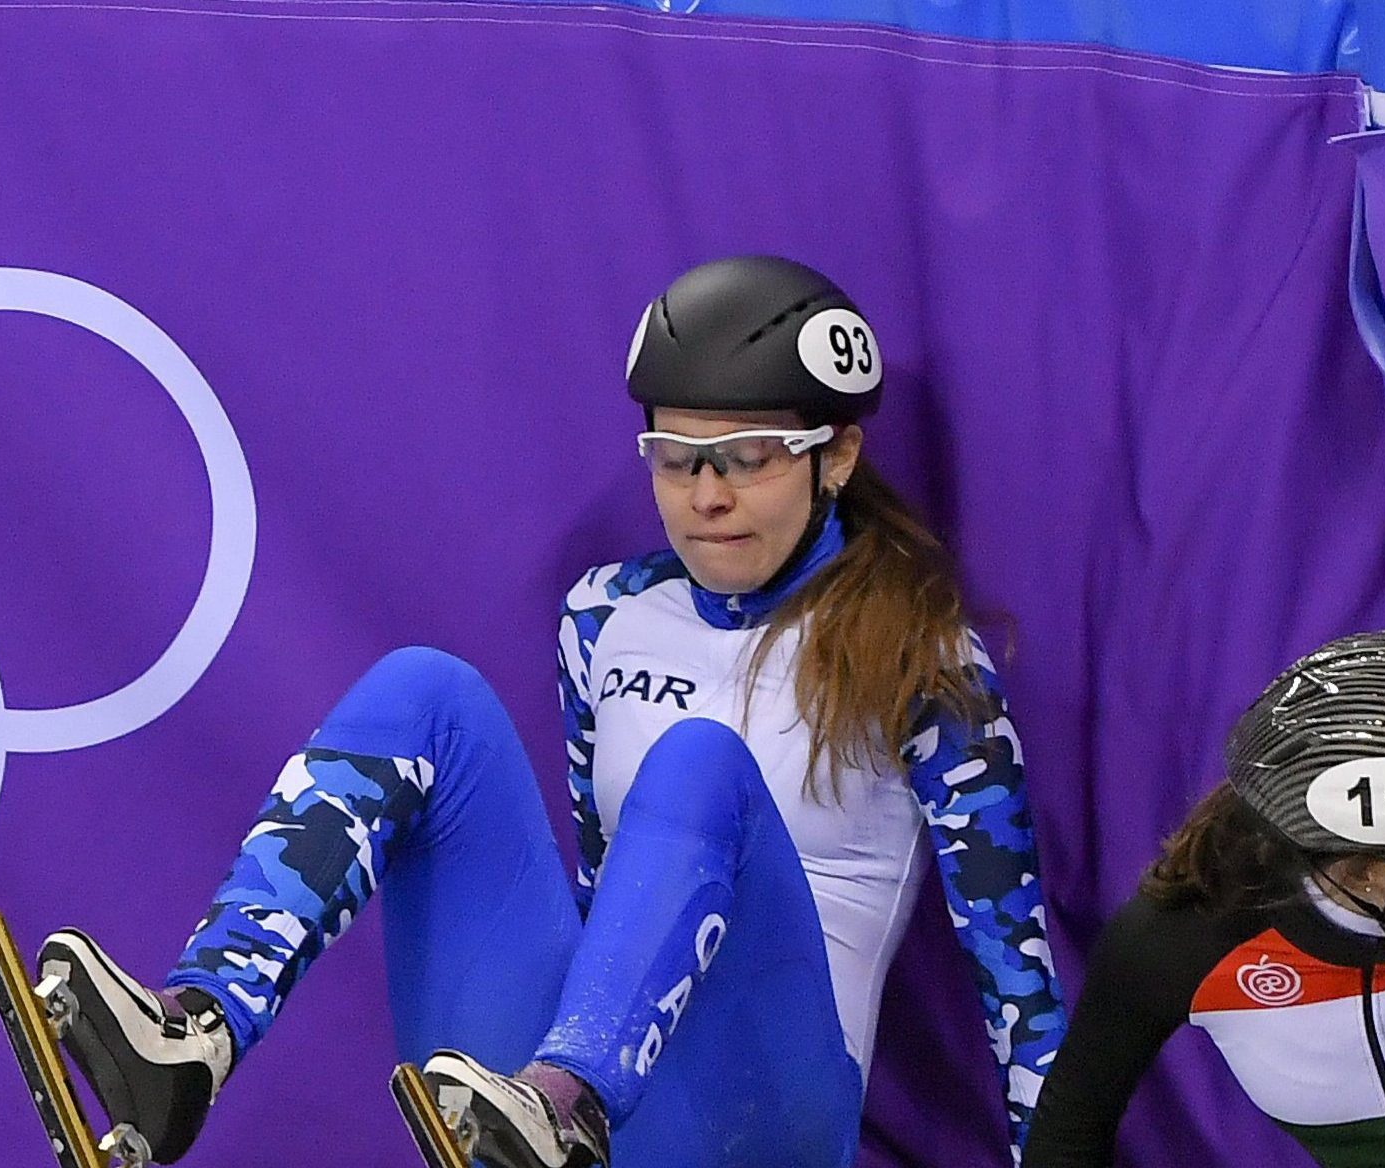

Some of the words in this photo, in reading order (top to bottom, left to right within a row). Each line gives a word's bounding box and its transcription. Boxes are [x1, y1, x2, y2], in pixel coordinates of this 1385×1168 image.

[829, 324, 873, 375] 93
[599, 667, 696, 710] OAR
[636, 913, 726, 1076] OAR
